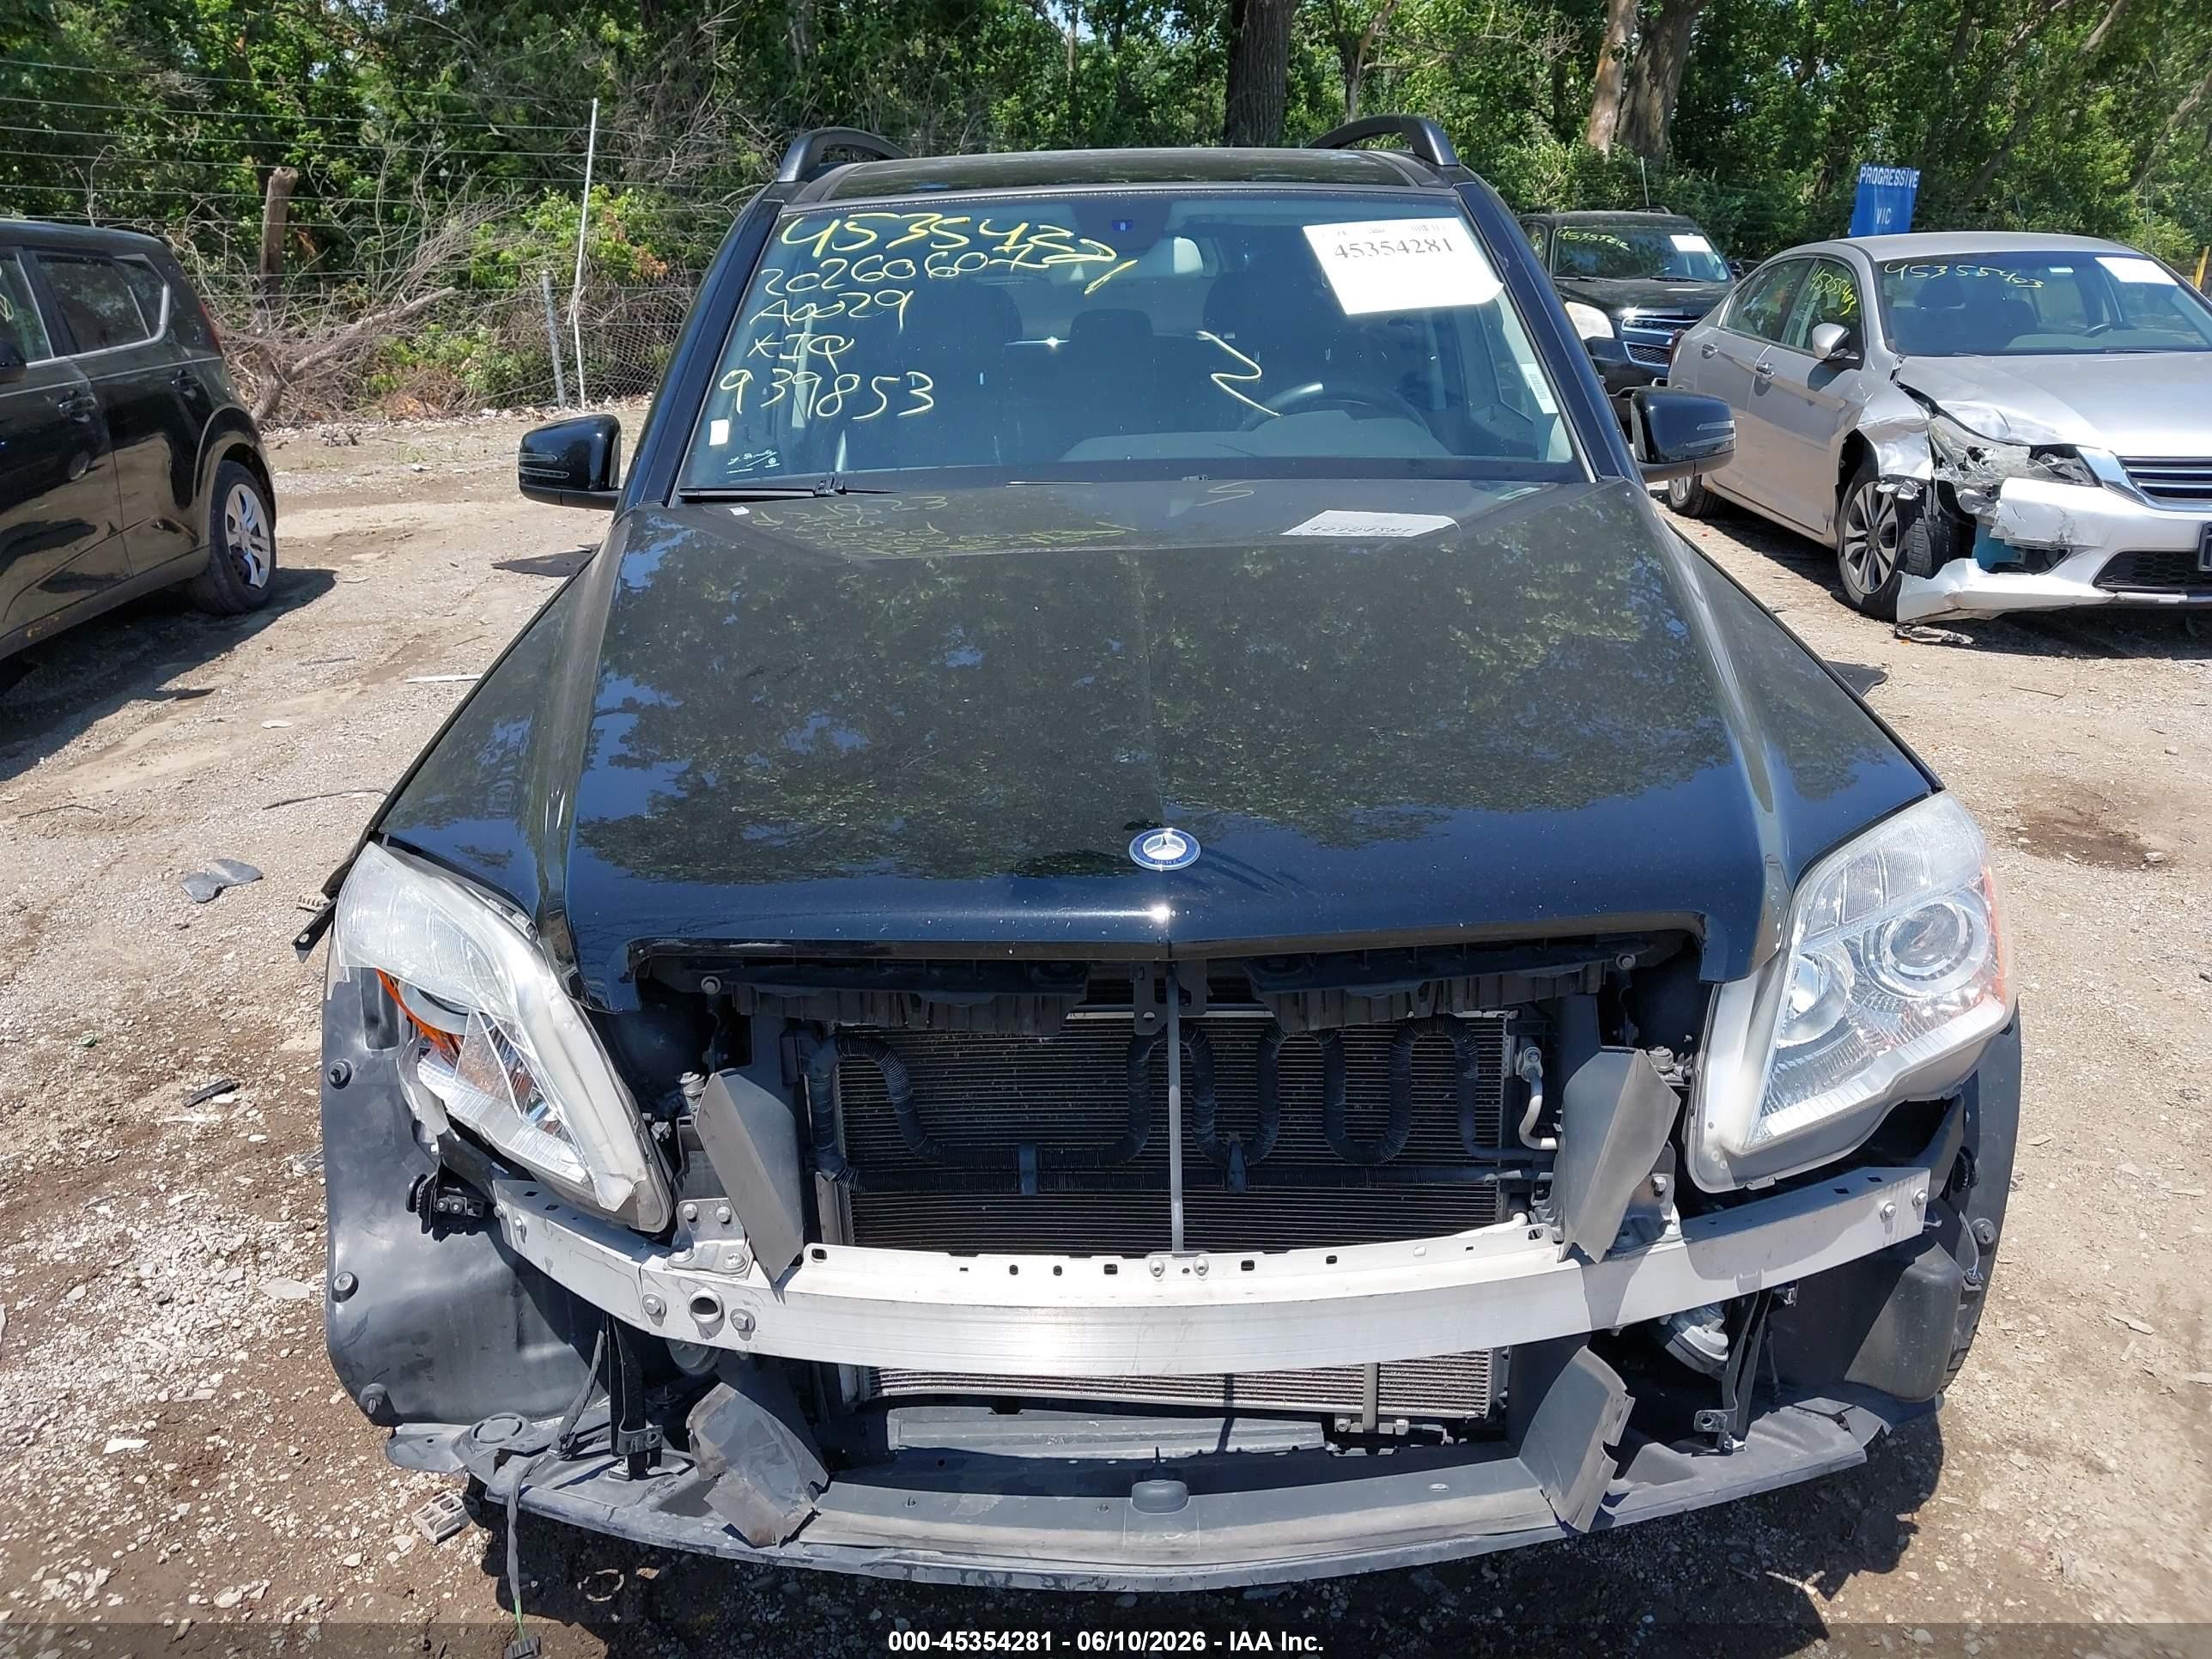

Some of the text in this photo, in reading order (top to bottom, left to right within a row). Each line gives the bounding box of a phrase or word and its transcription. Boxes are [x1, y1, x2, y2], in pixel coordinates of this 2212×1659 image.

[1858, 166, 1921, 188] PROGRESSIVE
[1875, 207, 1892, 224] VIC
[1334, 237, 1454, 258] 45354281
[719, 368, 934, 420] 939853
